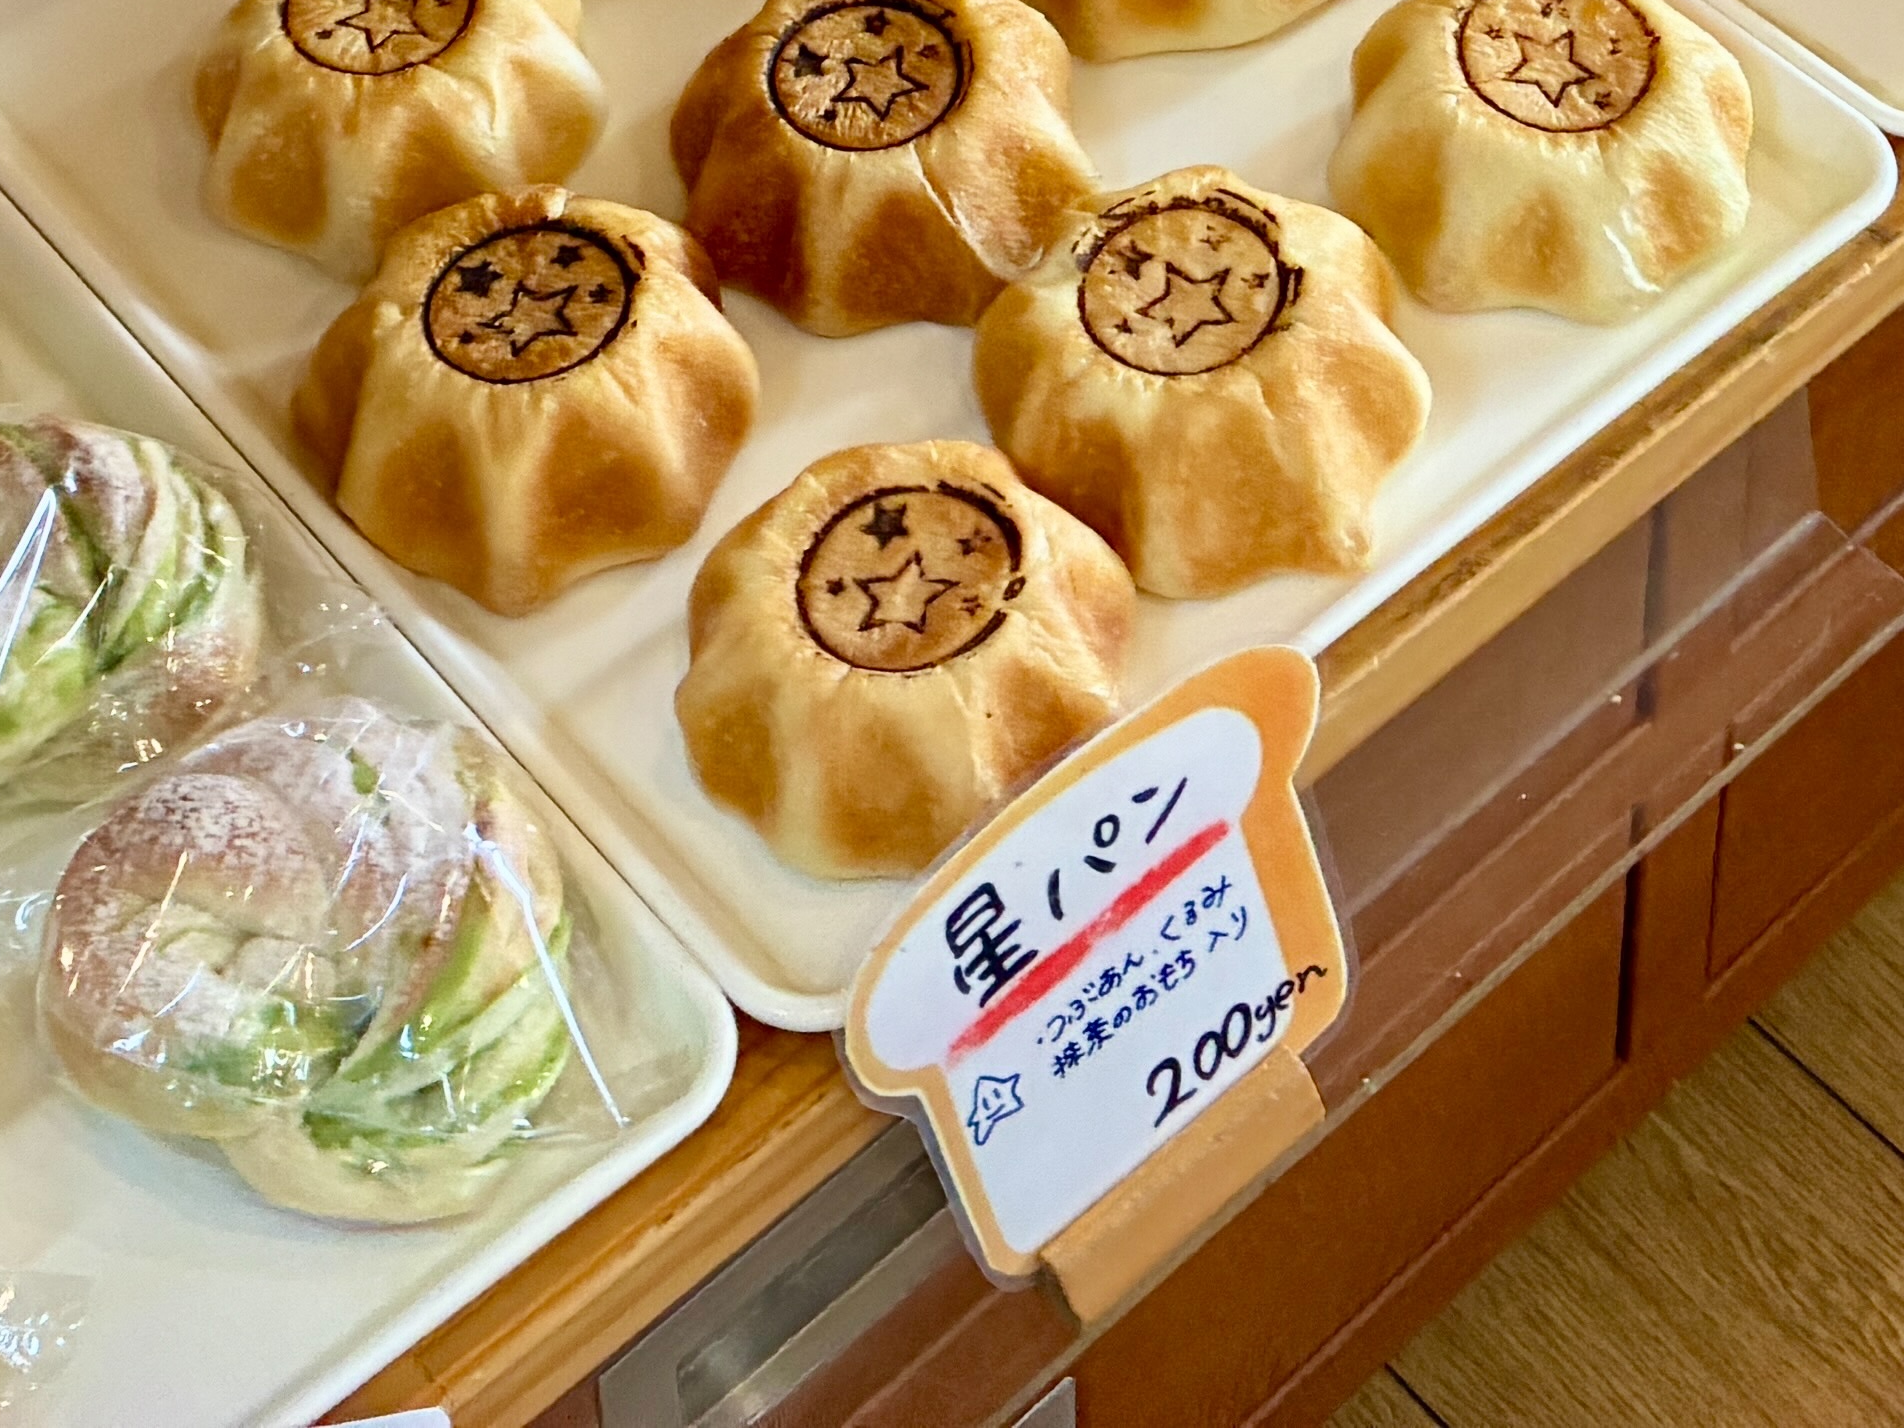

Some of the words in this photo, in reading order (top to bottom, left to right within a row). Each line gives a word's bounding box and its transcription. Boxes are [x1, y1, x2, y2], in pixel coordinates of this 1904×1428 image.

[945, 776, 1187, 1008] 星パン
[1146, 960, 1328, 1127] 200yen
